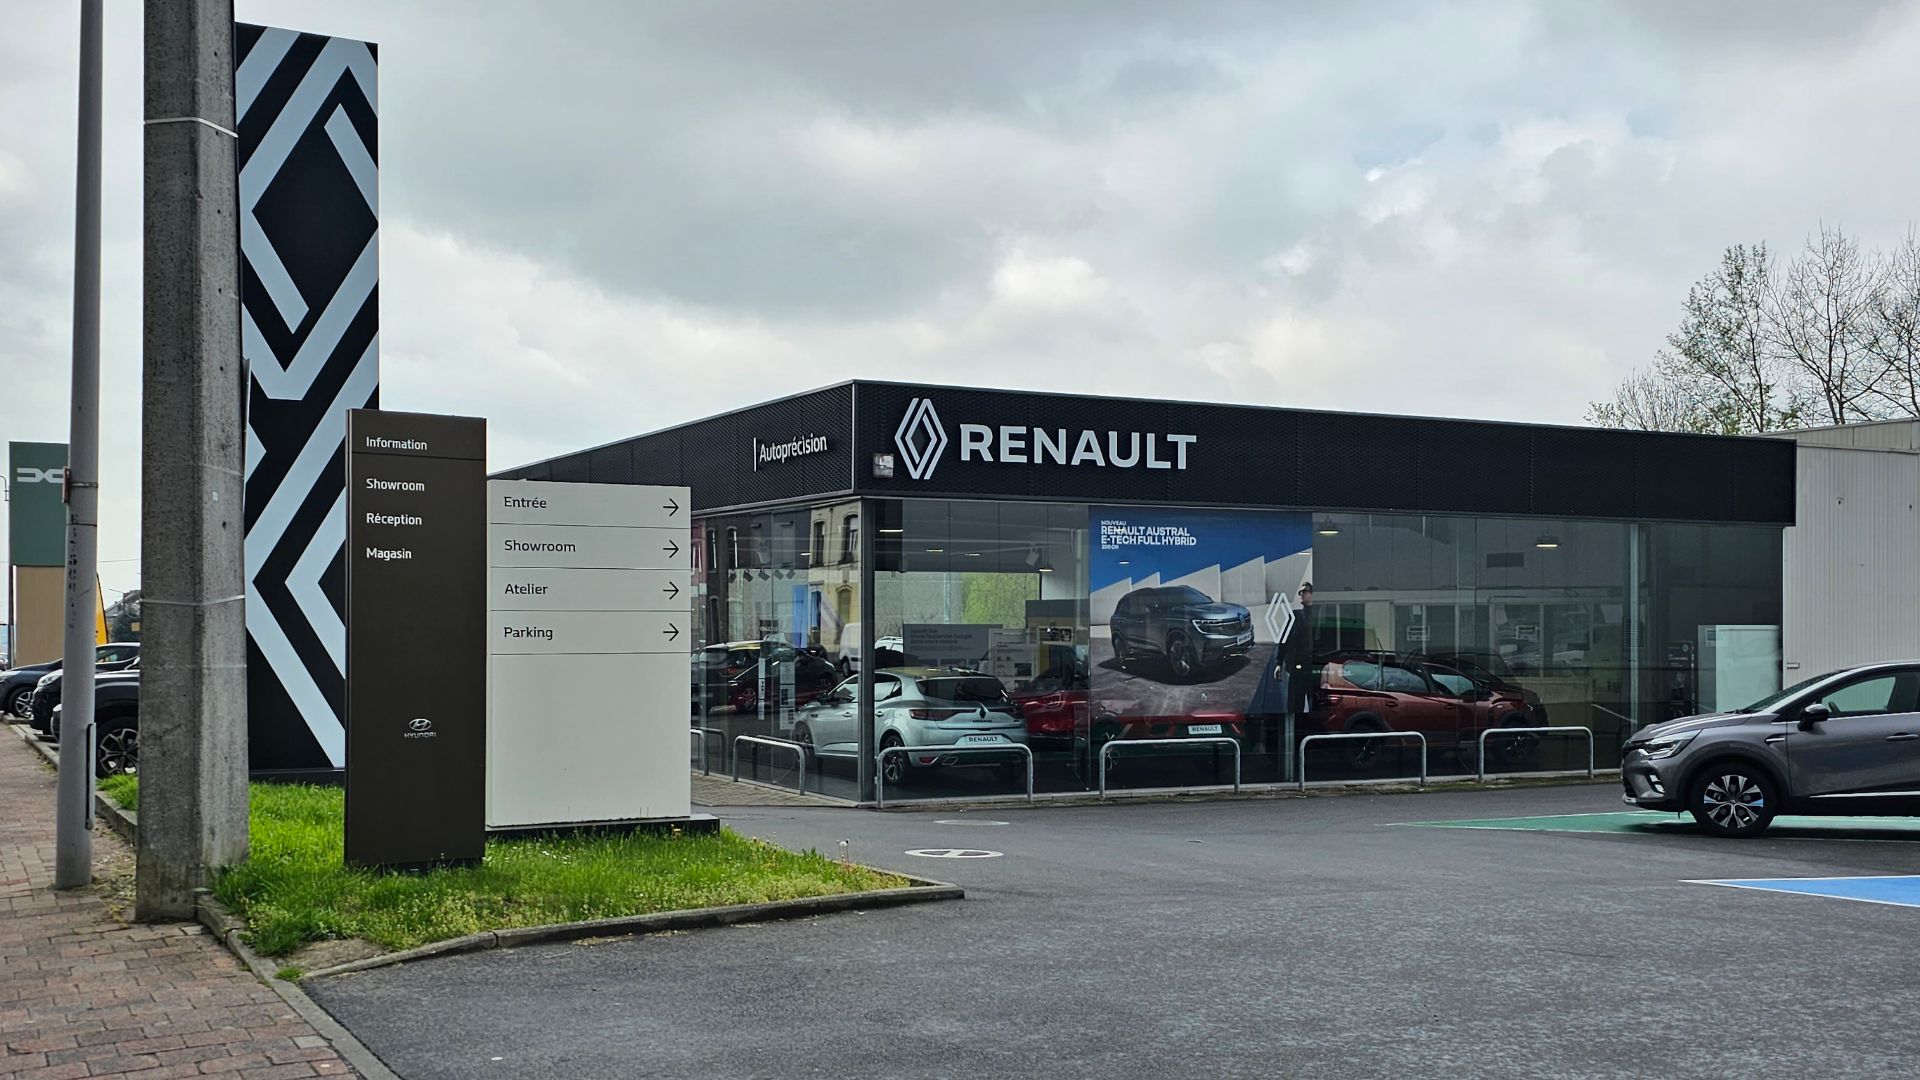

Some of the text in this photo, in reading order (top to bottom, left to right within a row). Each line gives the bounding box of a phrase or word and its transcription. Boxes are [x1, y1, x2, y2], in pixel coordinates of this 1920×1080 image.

[365, 436, 428, 451] Information
[758, 432, 828, 464] Autoprécision
[959, 423, 1198, 470] RENAULT
[365, 478, 425, 493] Showroom
[503, 495, 547, 510] Entrée
[365, 512, 422, 528] Réception
[1101, 526, 1190, 536] RENAULT AUSTRAL
[503, 539, 577, 554] Showroom
[1101, 535, 1197, 546] E-TECH FULL HYBRID
[366, 547, 413, 562] Magasin
[504, 582, 549, 596] Atelier
[503, 626, 554, 641] Parking
[403, 731, 437, 739] HYUNDAI
